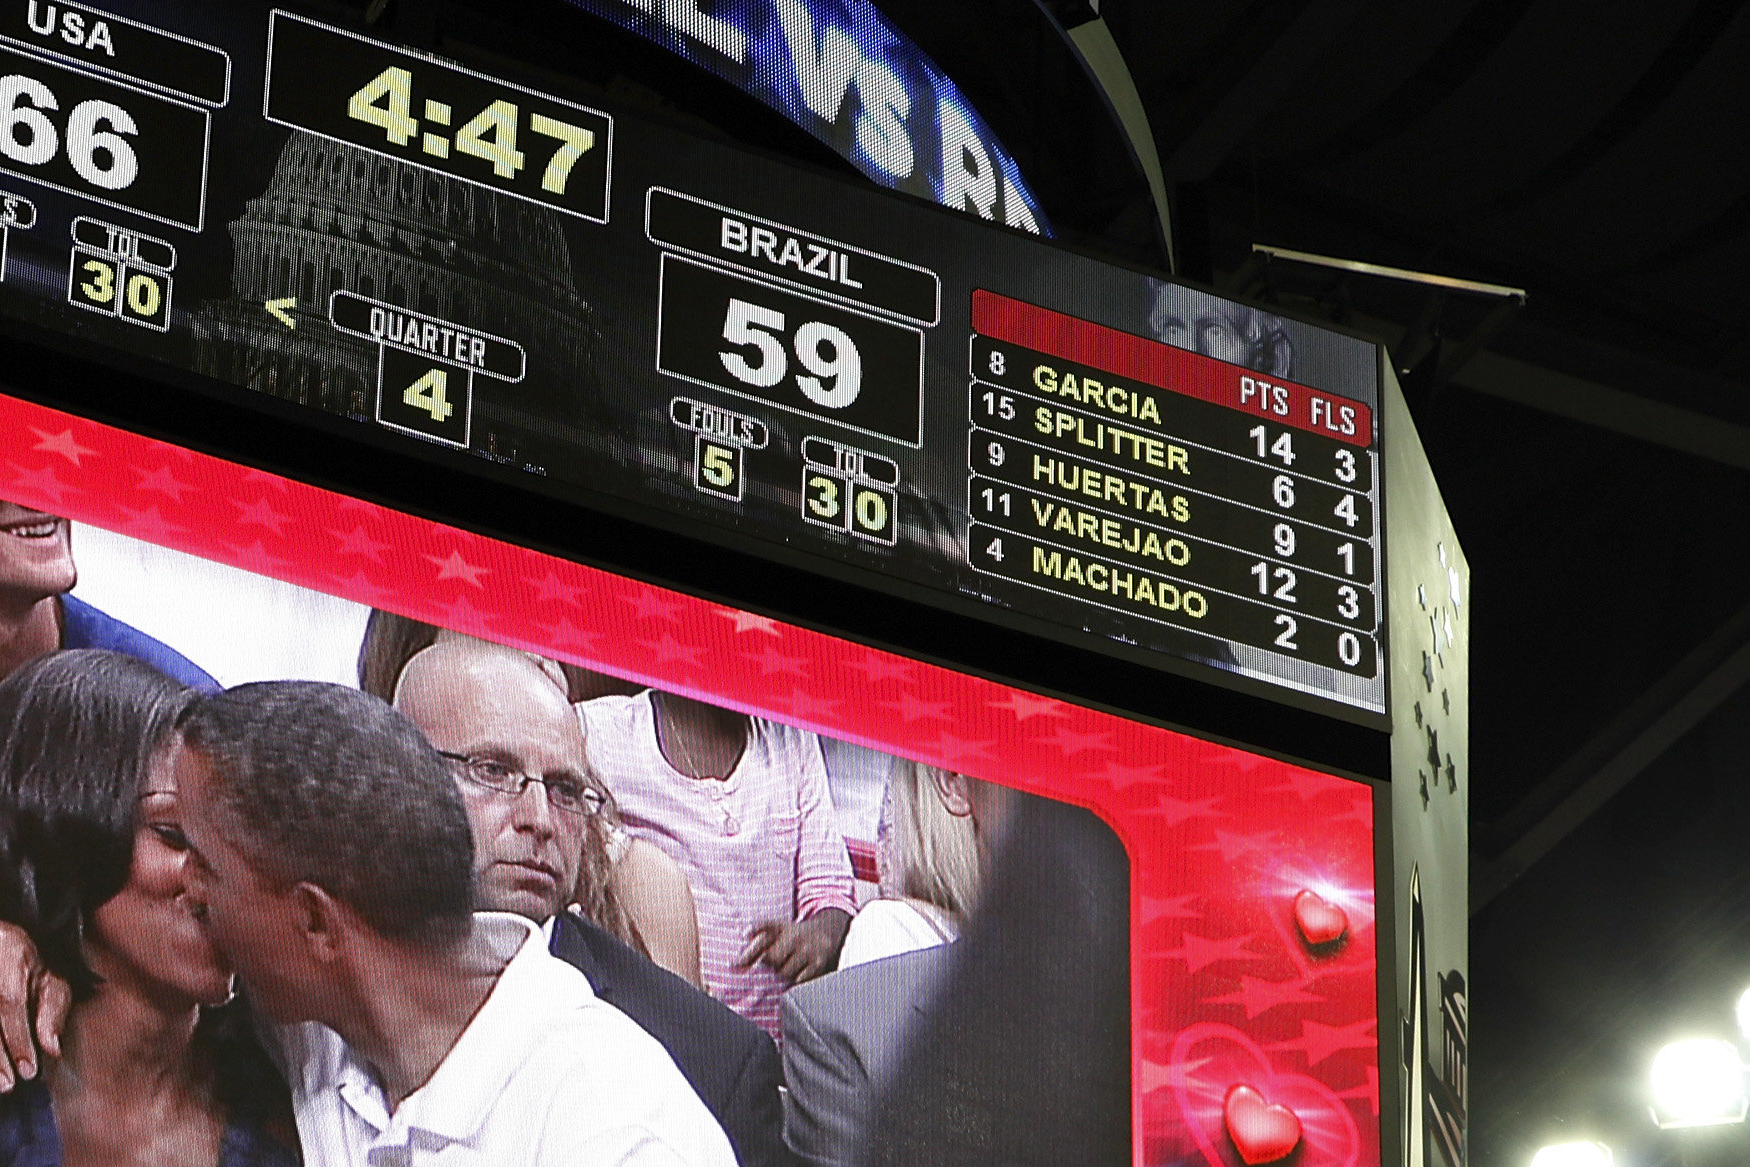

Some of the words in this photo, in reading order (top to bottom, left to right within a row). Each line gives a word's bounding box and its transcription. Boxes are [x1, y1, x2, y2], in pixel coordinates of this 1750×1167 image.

[27, 0, 116, 57] USA
[347, 66, 596, 195] 4:47
[721, 217, 863, 289] BRAZIL
[370, 306, 486, 367] QUARTER
[719, 297, 863, 409] 59
[402, 367, 453, 422] 4
[691, 404, 755, 446] FOULS
[988, 350, 1007, 376] 8
[1032, 363, 1163, 426] GARCIA
[1249, 424, 1297, 466] 14
[1334, 448, 1357, 484] 3
[1239, 375, 1289, 417] PTS
[1311, 395, 1357, 436] FLS
[702, 444, 735, 488] 5
[981, 391, 1017, 421] 15
[1033, 406, 1190, 476] SPLITTER
[1272, 474, 1295, 510] 6
[1332, 495, 1360, 530] 4
[981, 486, 1013, 518] 11
[1030, 496, 1191, 568] VAREJAO
[1250, 561, 1297, 601] 12
[1337, 585, 1360, 620] 3
[988, 439, 1007, 468] 9
[1032, 453, 1191, 524] HUERTAS
[1272, 522, 1296, 557] 9
[1336, 542, 1356, 576] 1
[985, 535, 1005, 563] 4
[1032, 545, 1208, 620] MACHADO
[1274, 616, 1298, 651] 2
[1337, 632, 1362, 668] 0
